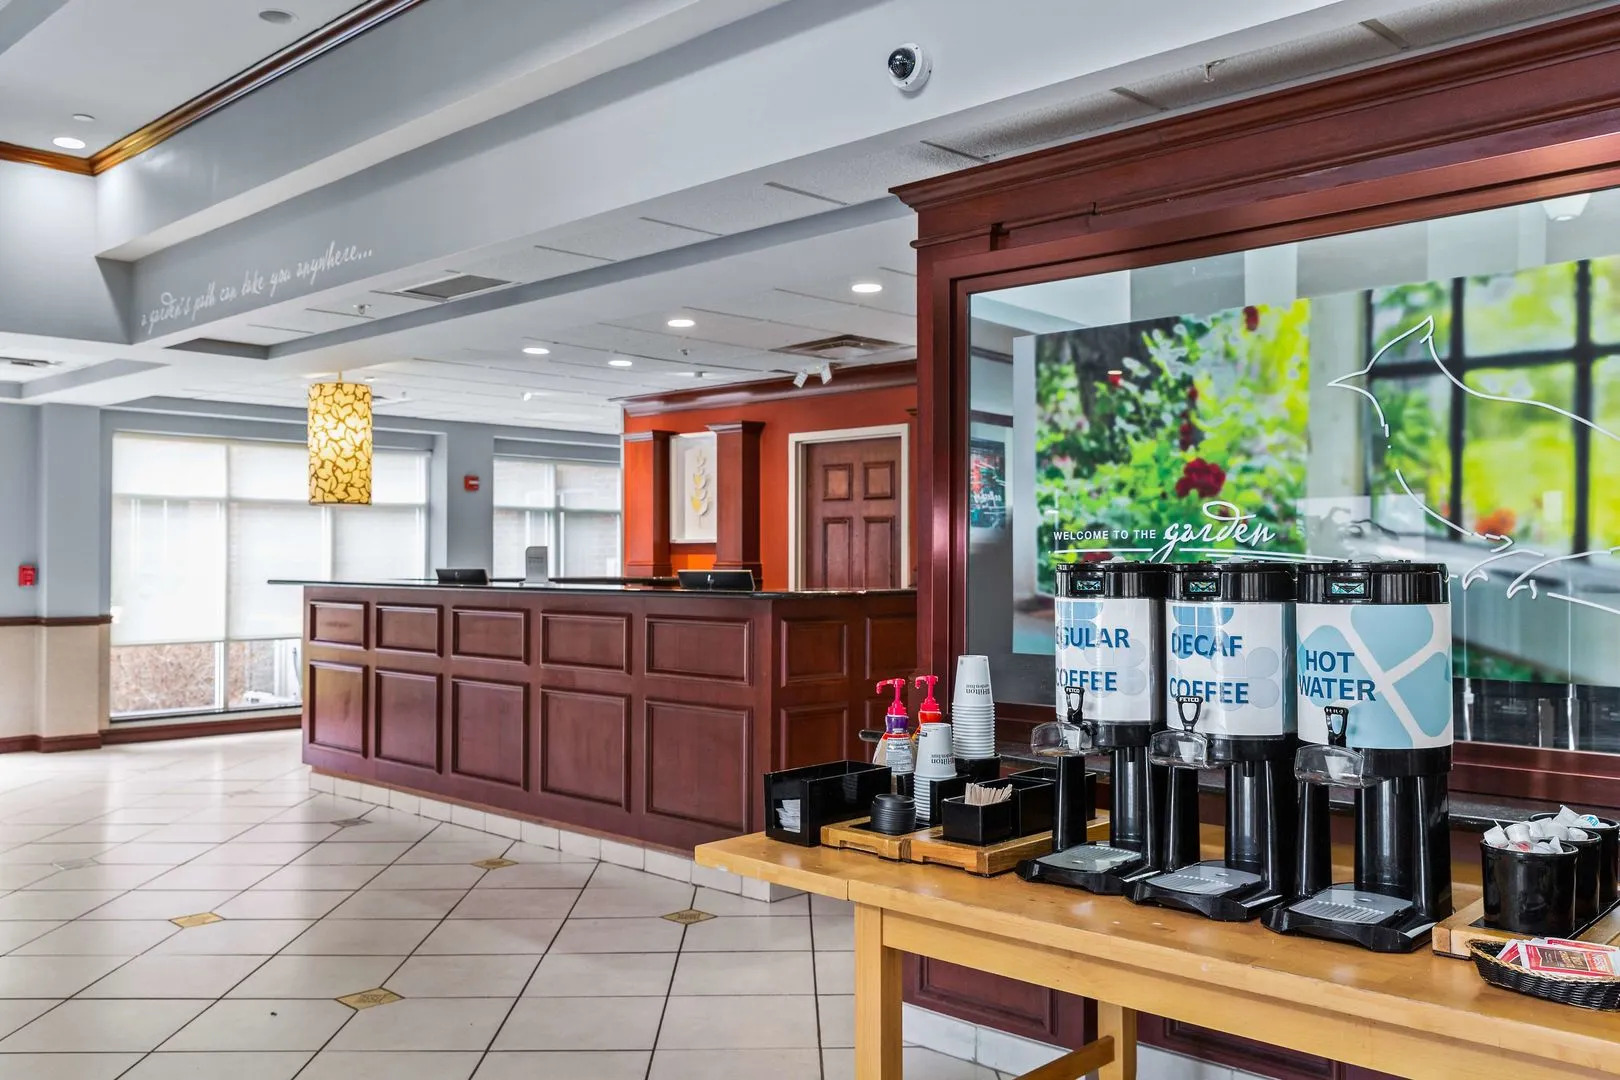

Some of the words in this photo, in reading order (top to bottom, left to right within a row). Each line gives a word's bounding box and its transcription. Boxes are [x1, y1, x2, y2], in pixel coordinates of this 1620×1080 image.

[191, 281, 216, 322] path
[219, 286, 238, 302] can
[241, 269, 264, 296] take
[270, 268, 291, 297] you
[1053, 531, 1109, 541] WELCOME
[1113, 530, 1129, 540] TO
[1133, 529, 1157, 540] THE
[1149, 500, 1277, 563] garden
[1056, 626, 1131, 649] GULAR
[1171, 632, 1244, 657] DECAF
[1305, 649, 1355, 674] HOT
[1169, 676, 1250, 704] COFFEE
[1298, 674, 1377, 702] WATER
